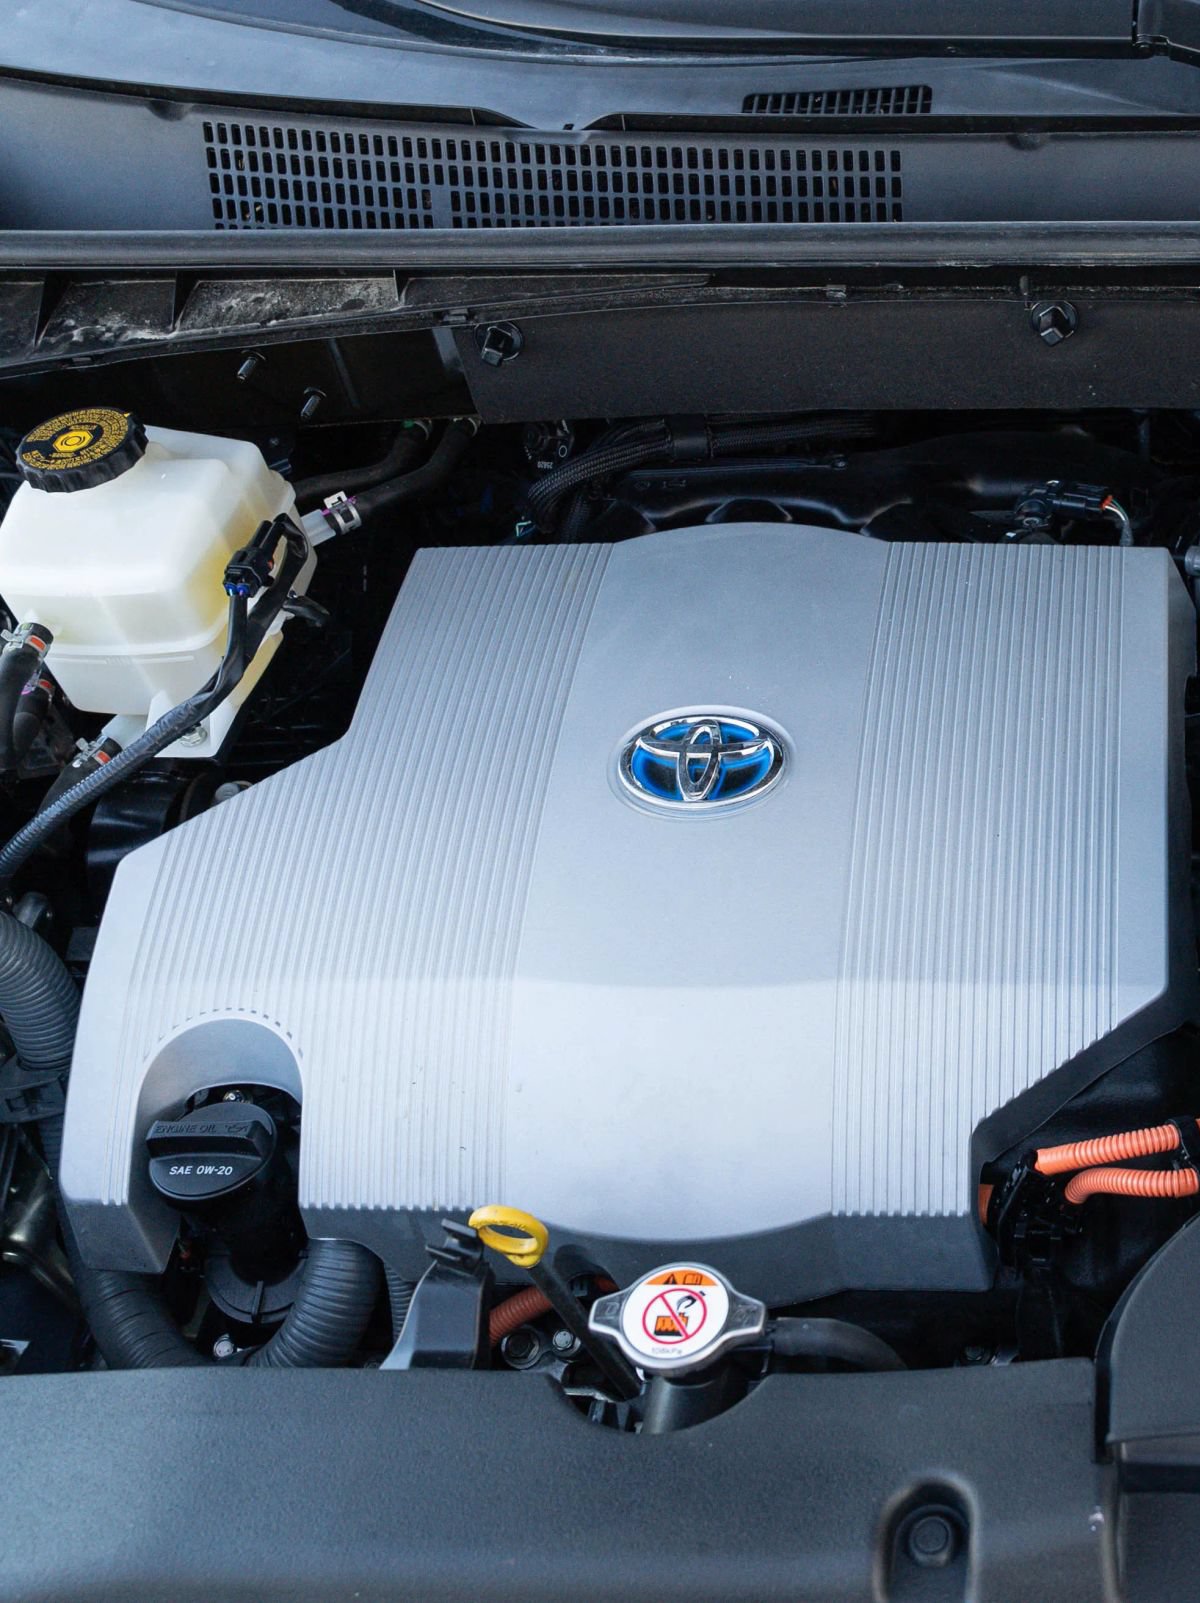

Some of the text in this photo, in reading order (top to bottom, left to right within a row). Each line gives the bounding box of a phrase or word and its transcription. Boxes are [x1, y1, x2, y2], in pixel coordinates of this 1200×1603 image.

[154, 1124, 217, 1134] ENGINE OIL
[169, 1165, 234, 1176] SAE 0W-20
